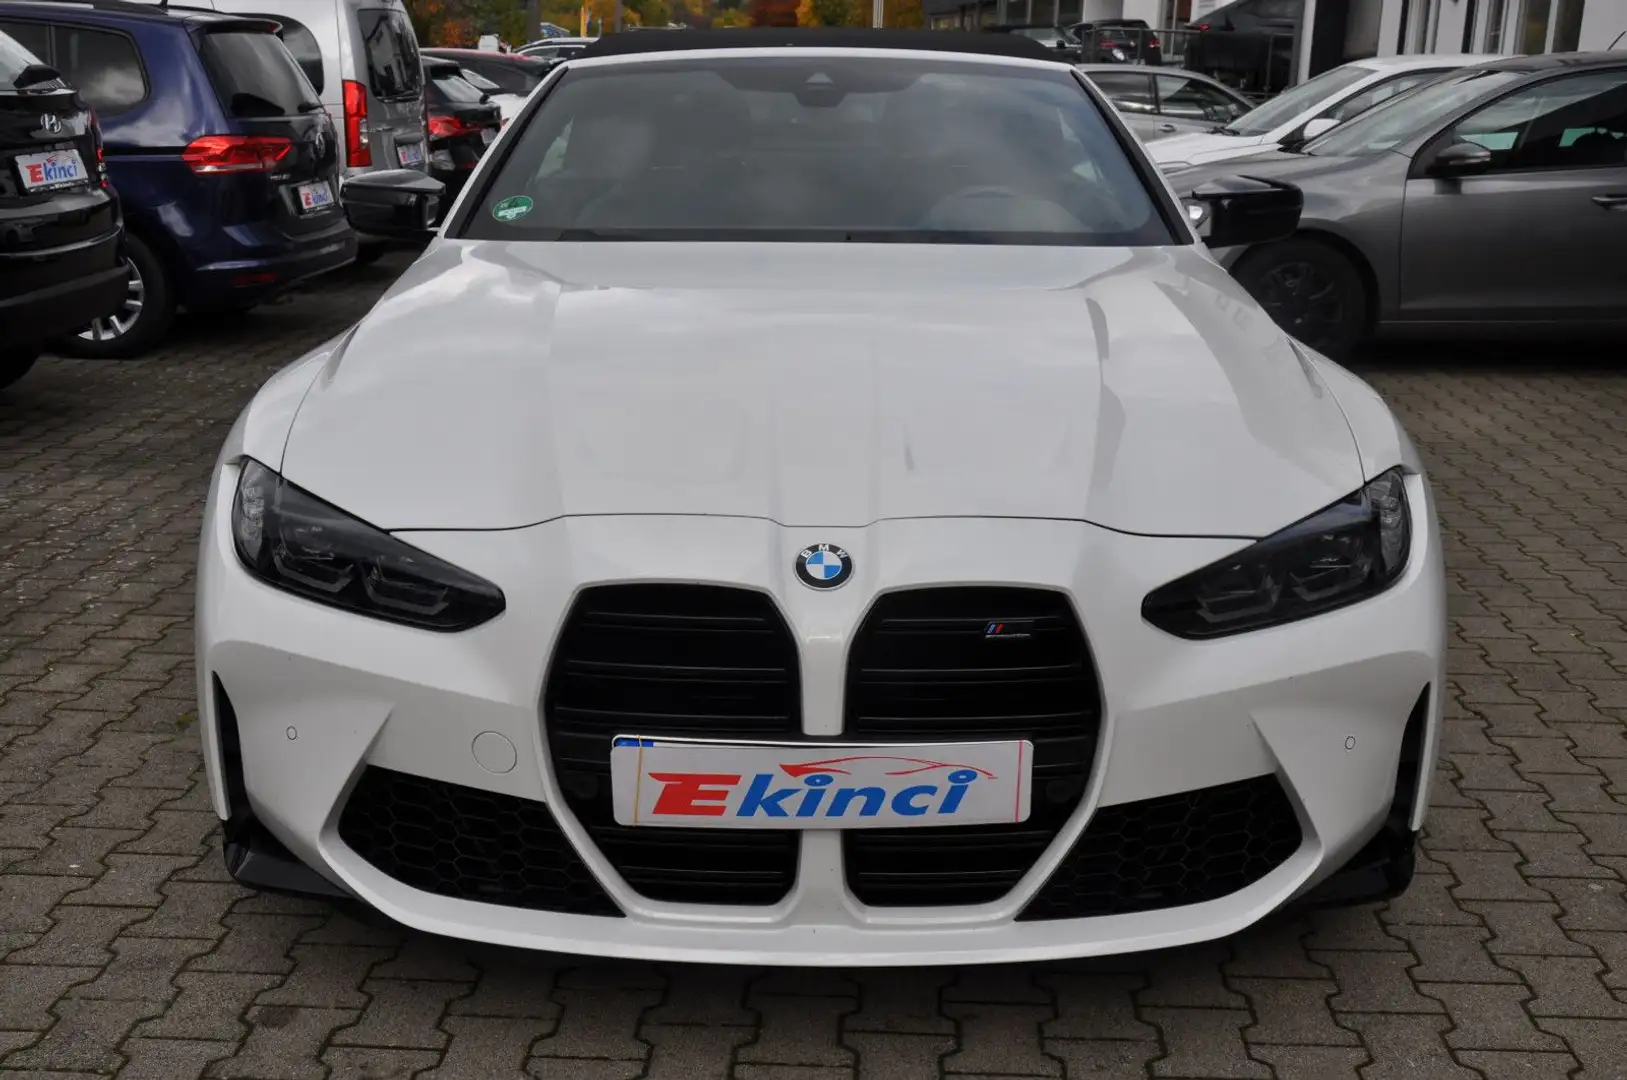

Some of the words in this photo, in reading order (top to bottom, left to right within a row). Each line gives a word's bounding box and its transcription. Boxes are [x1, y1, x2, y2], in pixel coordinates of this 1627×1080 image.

[25, 160, 77, 183] Ekinci
[801, 544, 848, 559] BMW
[648, 769, 978, 817] Ekinci
